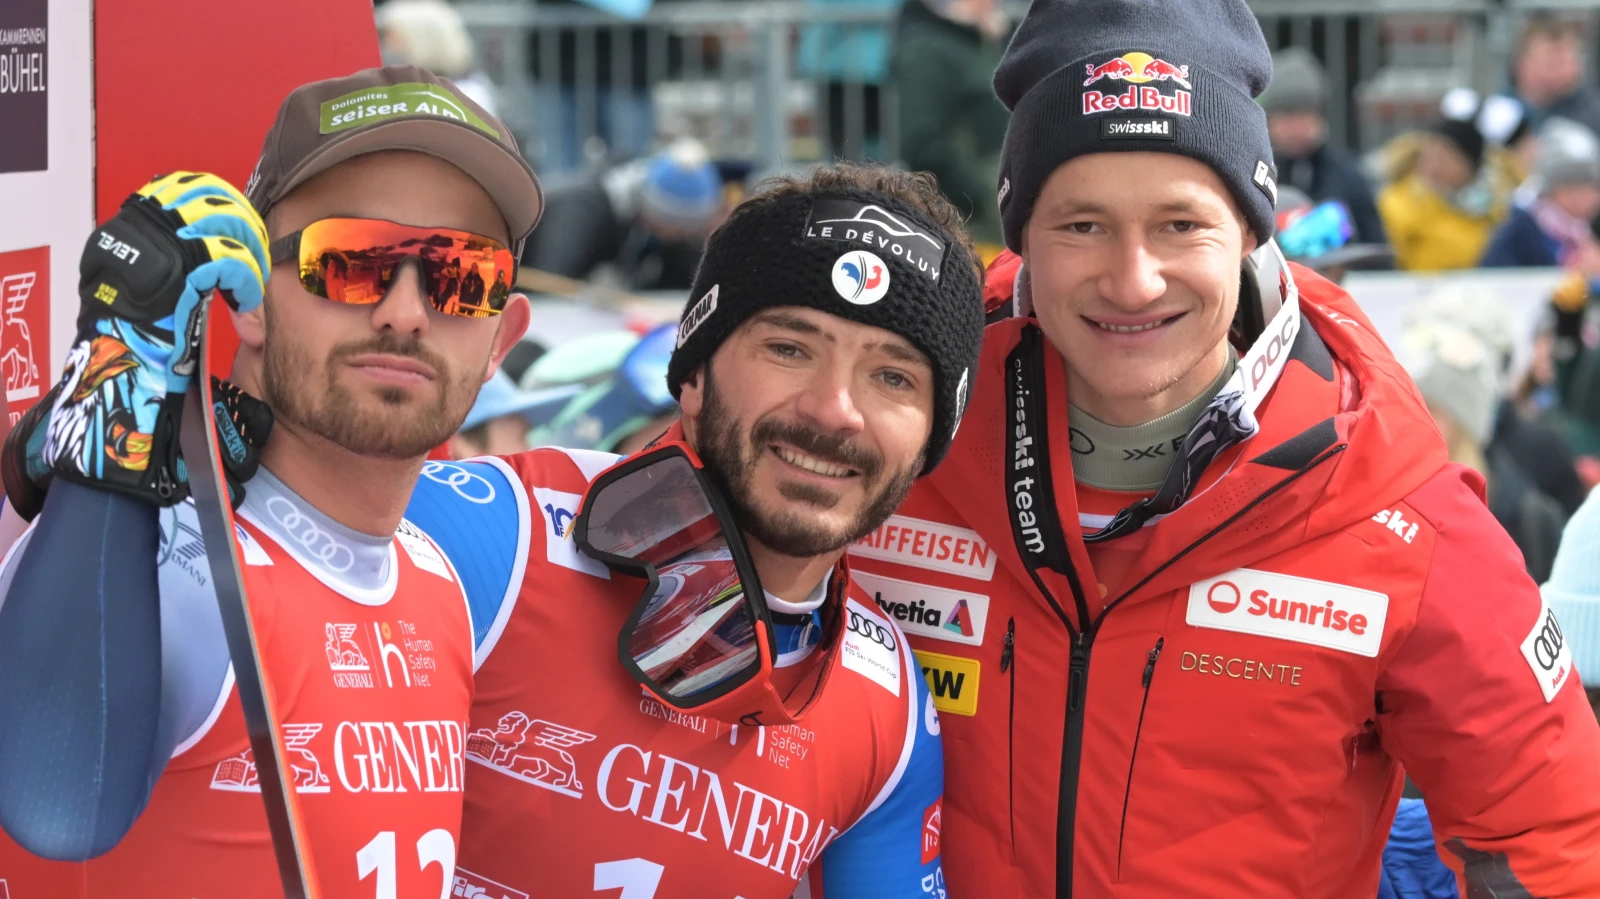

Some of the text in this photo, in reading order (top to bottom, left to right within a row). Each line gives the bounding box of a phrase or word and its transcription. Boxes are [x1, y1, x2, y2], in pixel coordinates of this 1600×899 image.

[0, 46, 46, 93] BÜHEL
[331, 93, 388, 111] Dolomites
[1083, 84, 1191, 117] Red Bull
[1109, 120, 1169, 134] swissski
[97, 231, 141, 265] LEVEL
[807, 226, 940, 280] LE DÉVOLUY
[681, 293, 713, 339] COLMAR
[1013, 476, 1046, 554] team
[1371, 509, 1419, 545] ski
[854, 524, 989, 568] AIFFEISEN
[398, 620, 416, 635] The
[1247, 589, 1368, 636] Sunrise
[403, 638, 434, 652] Human
[408, 654, 437, 673] Safety
[412, 672, 432, 687] Net
[1180, 651, 1303, 686] DESCENTE
[333, 672, 375, 689] GENERALI
[769, 747, 790, 769] Net
[771, 731, 809, 760] Safety
